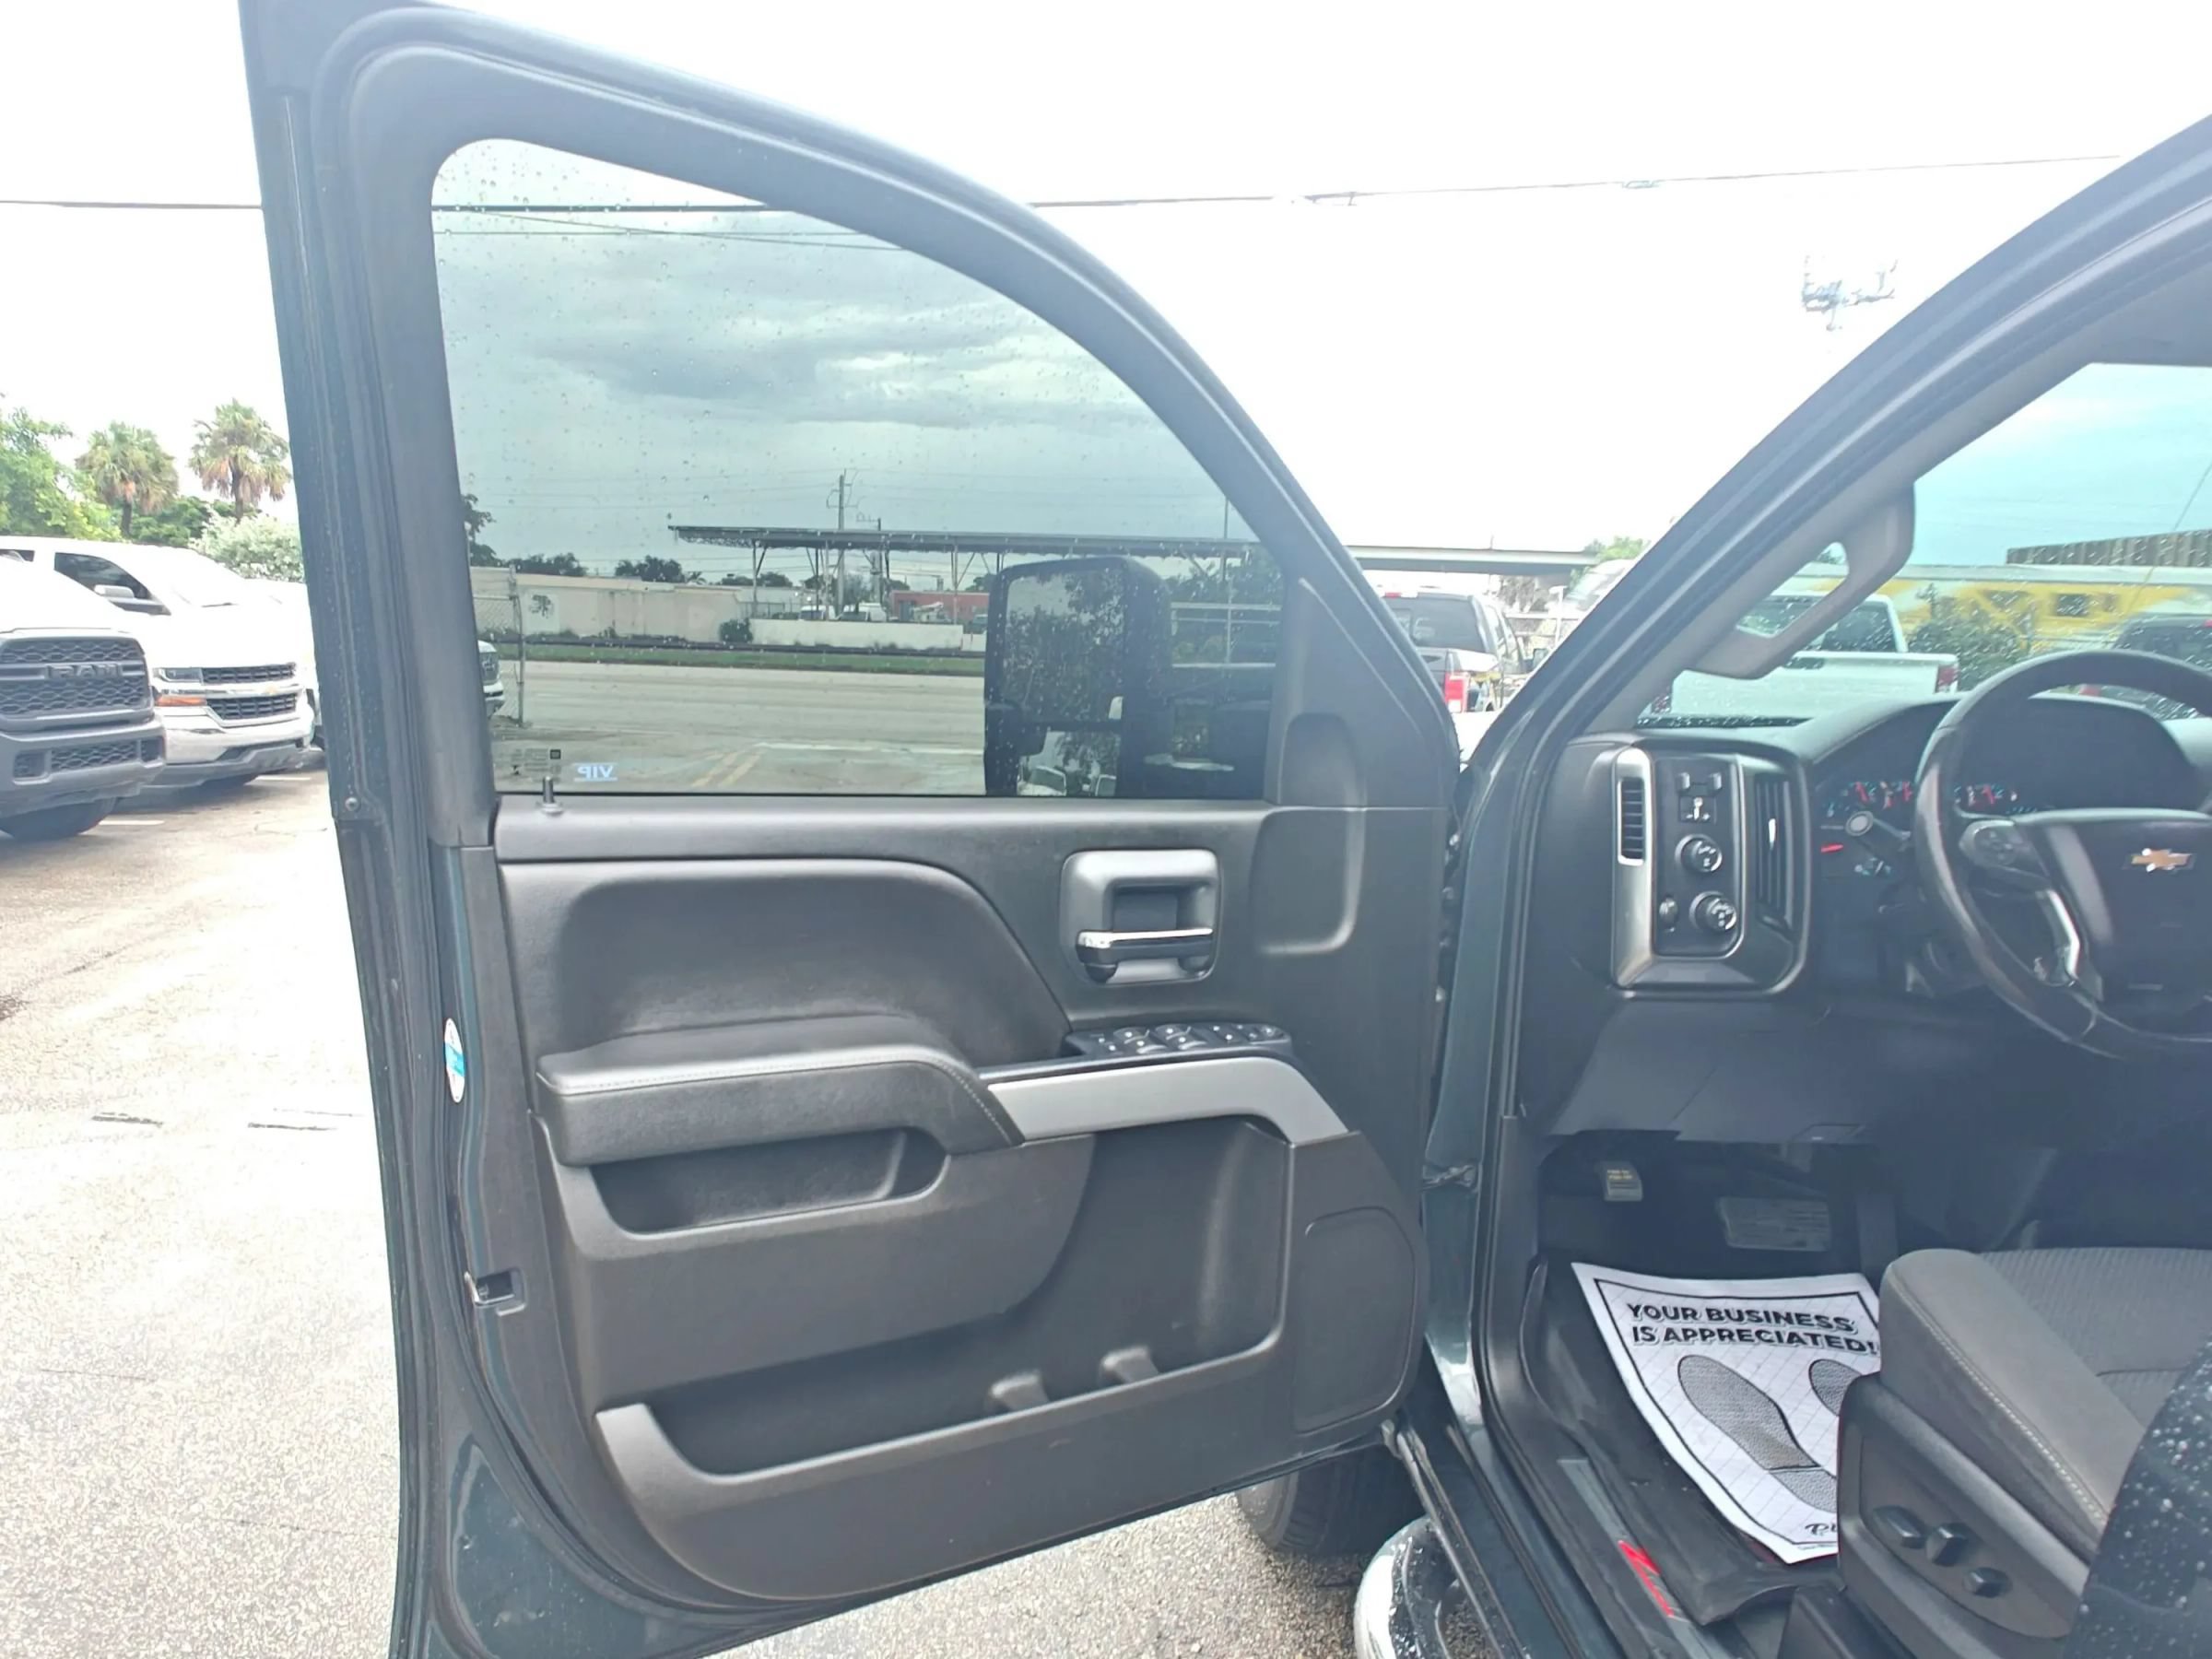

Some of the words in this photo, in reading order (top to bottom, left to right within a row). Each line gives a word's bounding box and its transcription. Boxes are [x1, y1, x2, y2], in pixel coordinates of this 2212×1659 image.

[50, 663, 121, 680] RAM
[1627, 1303, 1699, 1321] YOUR
[1705, 1307, 1856, 1334] BUSINESS
[1632, 1325, 1658, 1344] IS
[1663, 1327, 1878, 1356] APPRECIATED!
